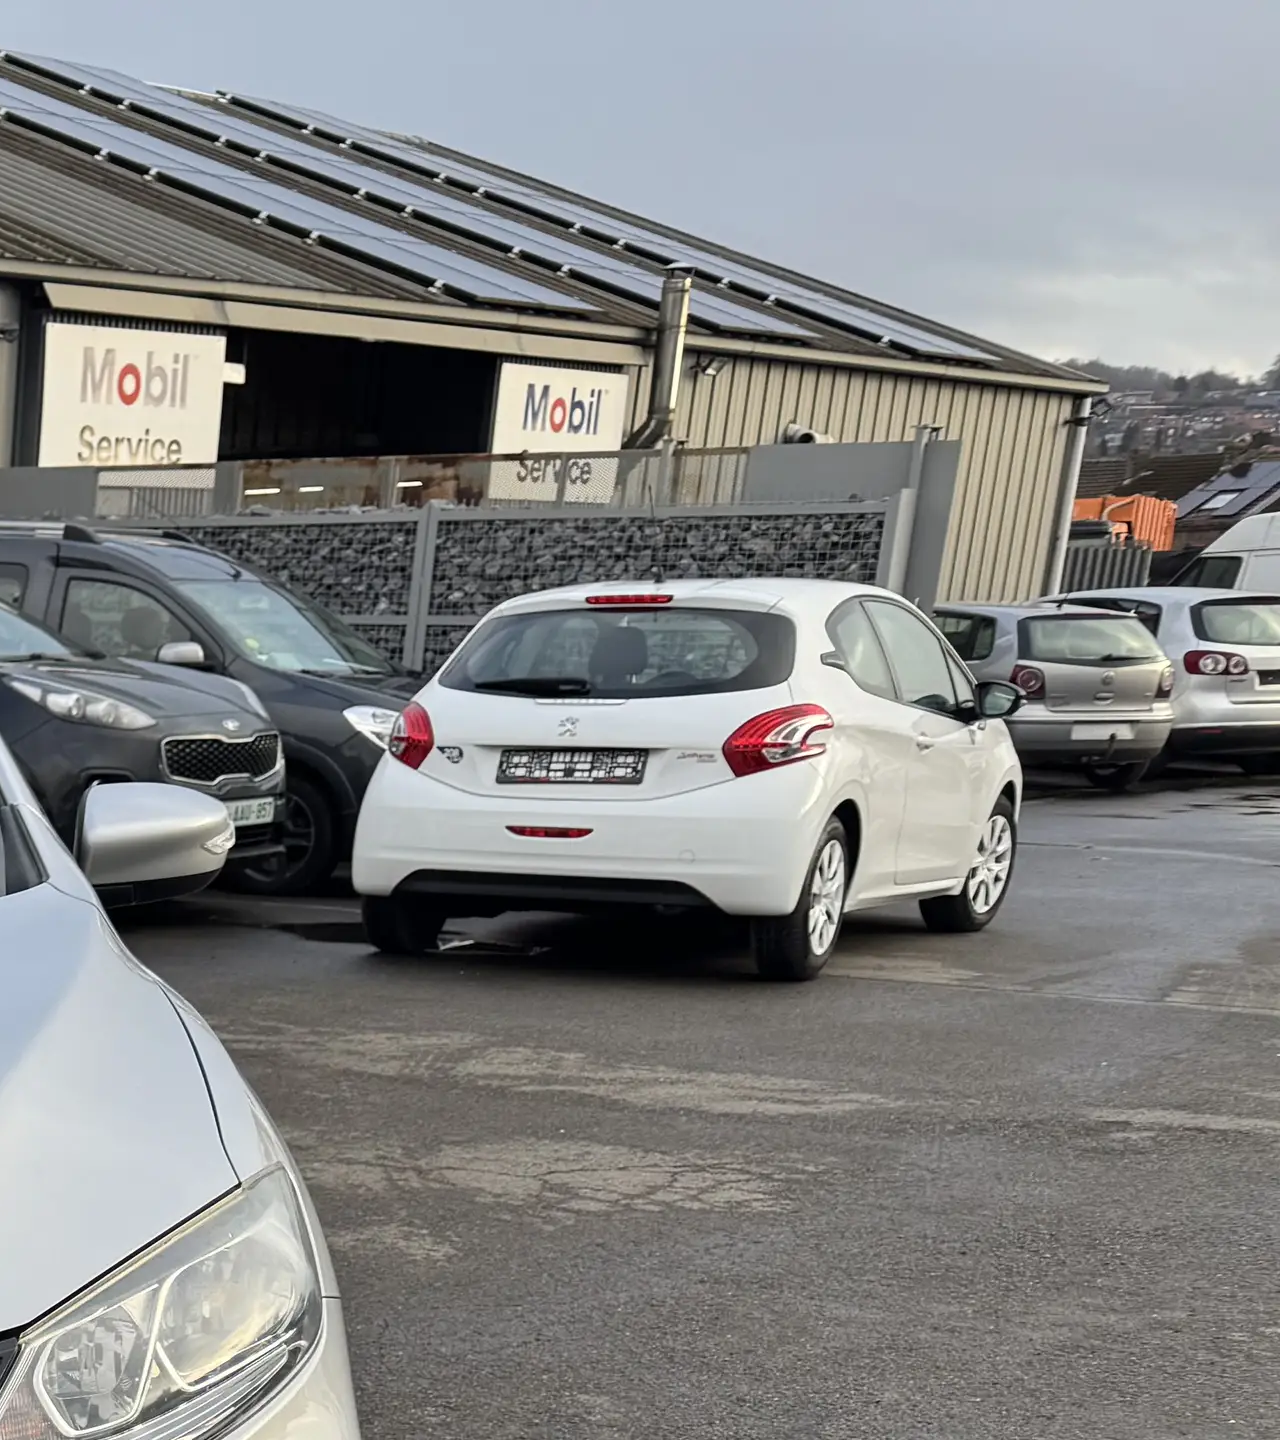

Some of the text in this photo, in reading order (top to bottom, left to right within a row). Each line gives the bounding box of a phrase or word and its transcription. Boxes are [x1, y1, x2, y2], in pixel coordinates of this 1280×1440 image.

[80, 346, 190, 409] Mobil
[522, 383, 602, 436] Mobil
[77, 424, 182, 464] Service
